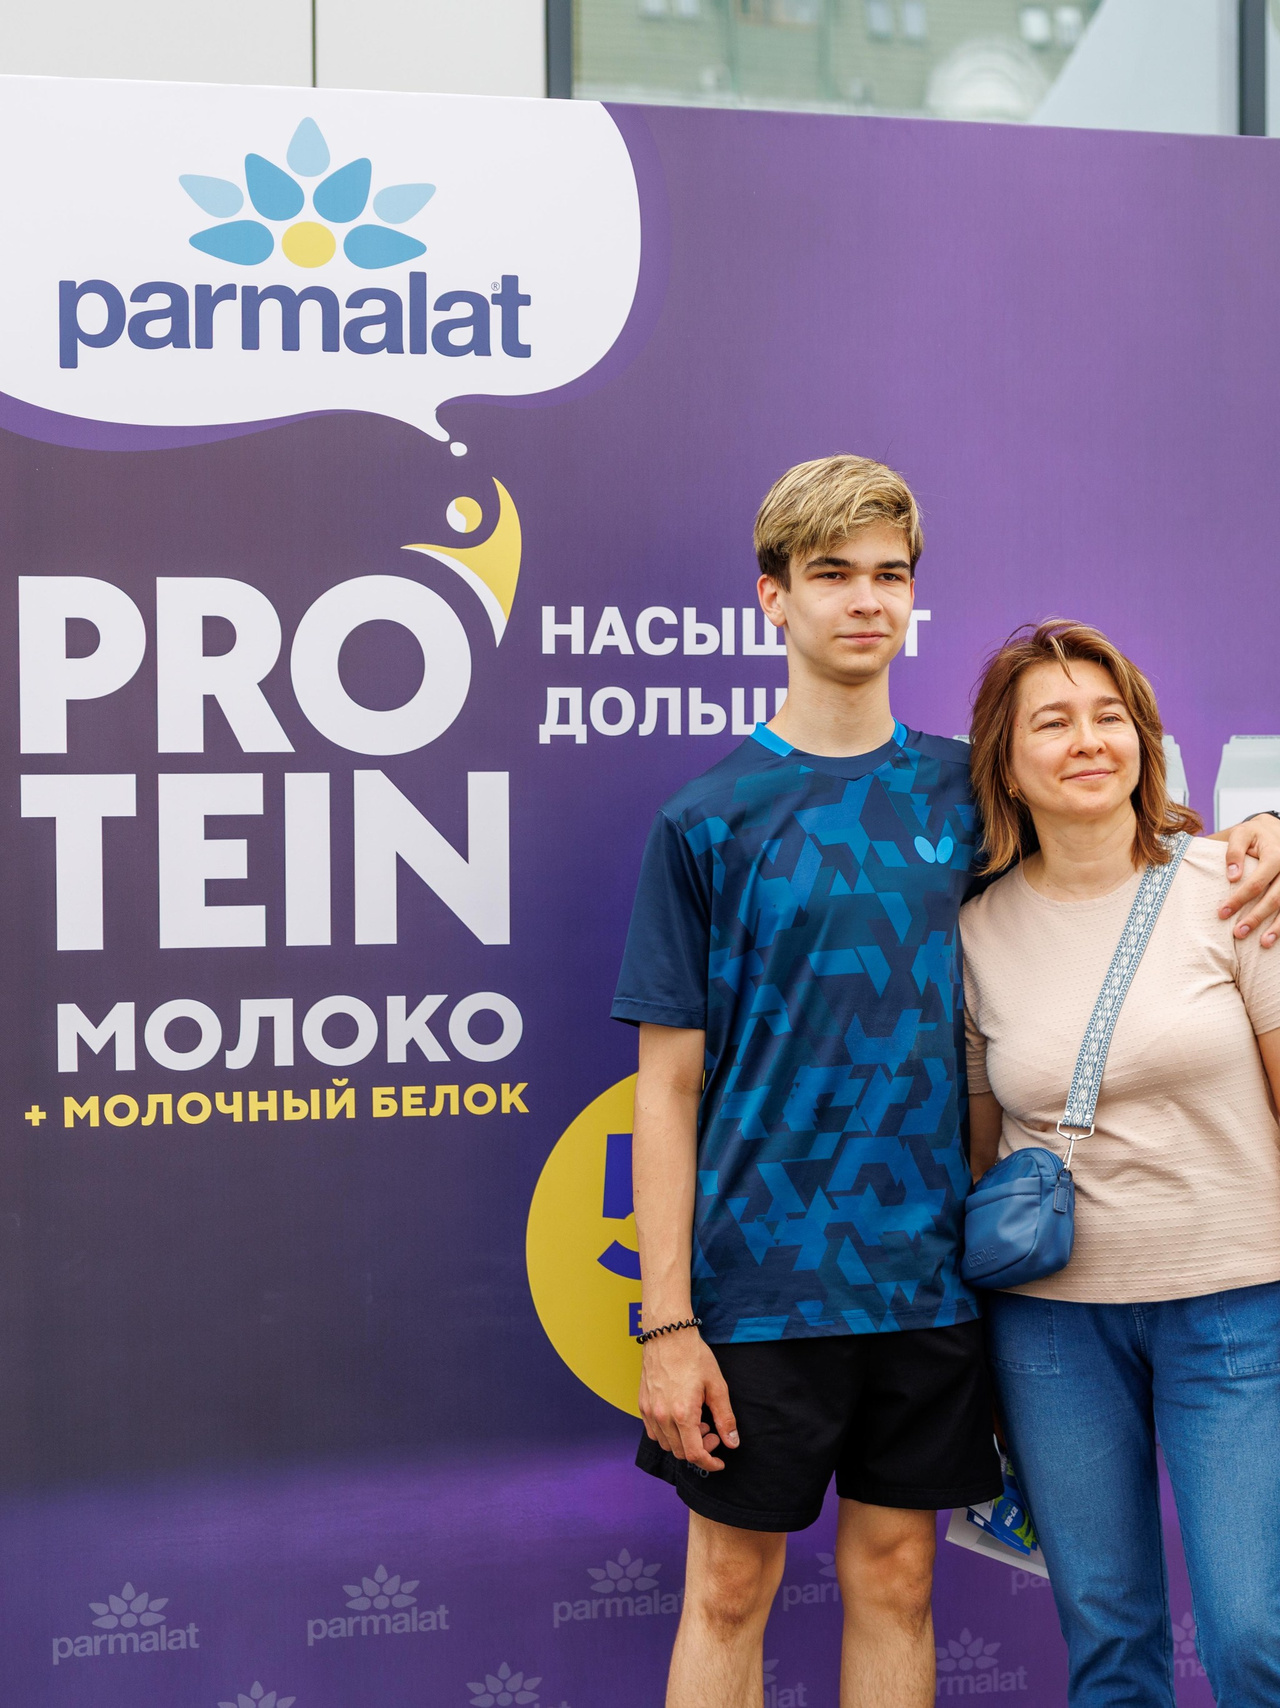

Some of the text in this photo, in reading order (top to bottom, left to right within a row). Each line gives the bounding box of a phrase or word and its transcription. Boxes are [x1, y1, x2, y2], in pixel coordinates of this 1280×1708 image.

[58, 271, 532, 369] parmalat
[541, 605, 931, 657] НАСЫЩТ
[18, 574, 473, 757] PRO
[538, 686, 788, 744] ДОЛЬШ
[20, 769, 511, 951] TEIN
[56, 991, 524, 1073] МОЛОКО
[63, 1077, 357, 1128] МОЛОЧНЫЙ
[371, 1082, 531, 1118] БЕЛОК
[52, 1622, 199, 1664] parmalat
[307, 1604, 450, 1645] parmalat
[936, 1665, 1028, 1697] rmalat
